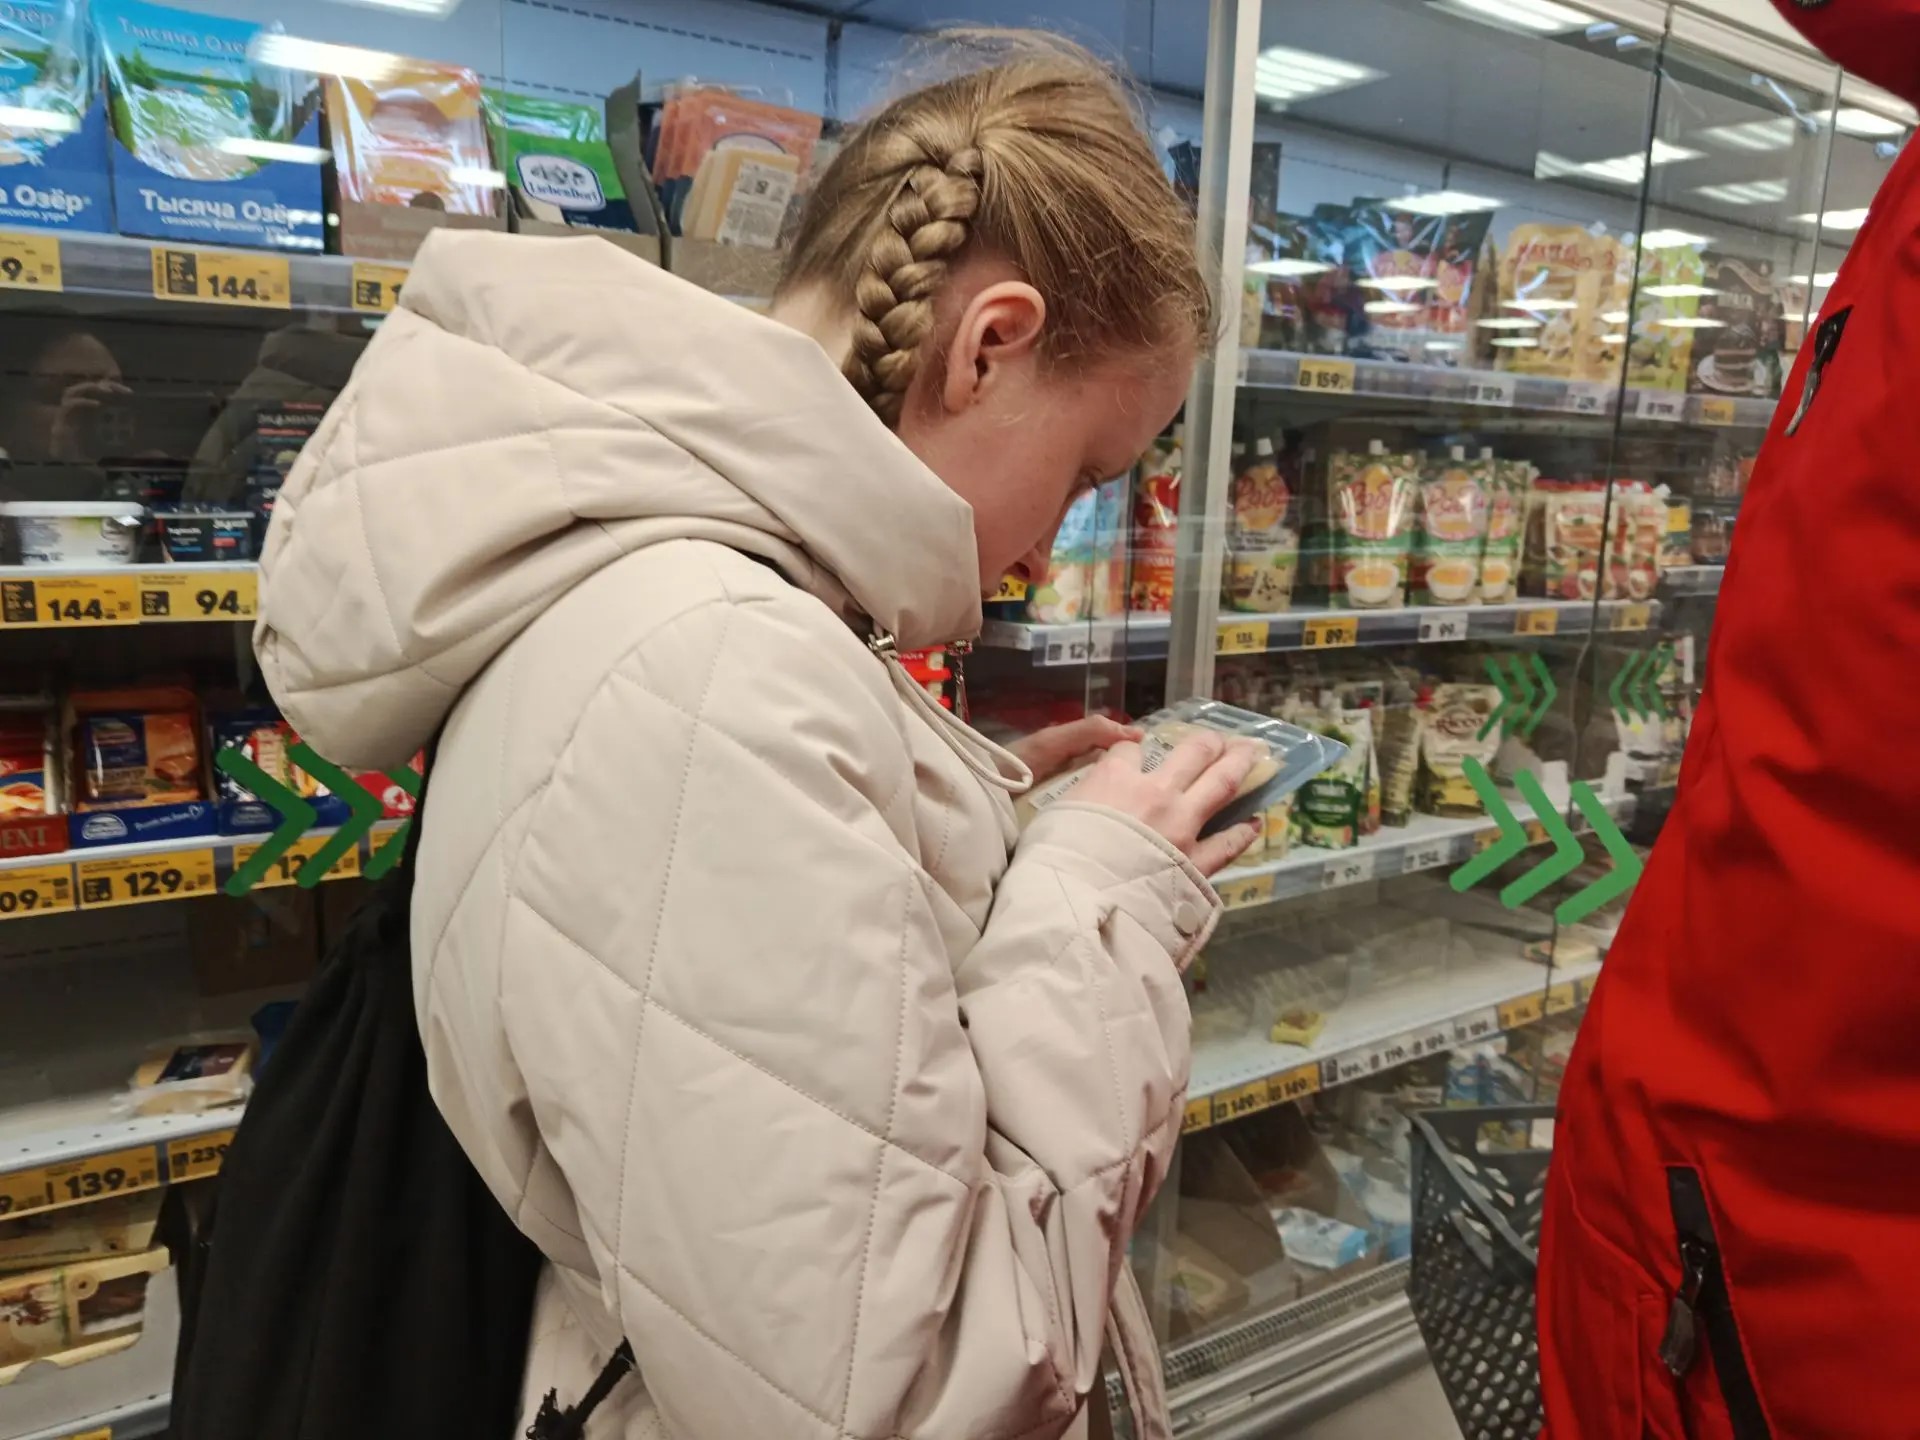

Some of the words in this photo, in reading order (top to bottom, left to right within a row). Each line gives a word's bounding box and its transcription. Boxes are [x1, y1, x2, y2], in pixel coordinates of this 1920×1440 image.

[118, 16, 199, 48] Тысяча
[14, 186, 83, 216] Озёр
[139, 189, 235, 220] Тысяча
[207, 275, 258, 299] 144
[48, 598, 103, 621] 144
[195, 589, 240, 615] 94
[124, 868, 182, 897] 129
[65, 1167, 125, 1199] 139
